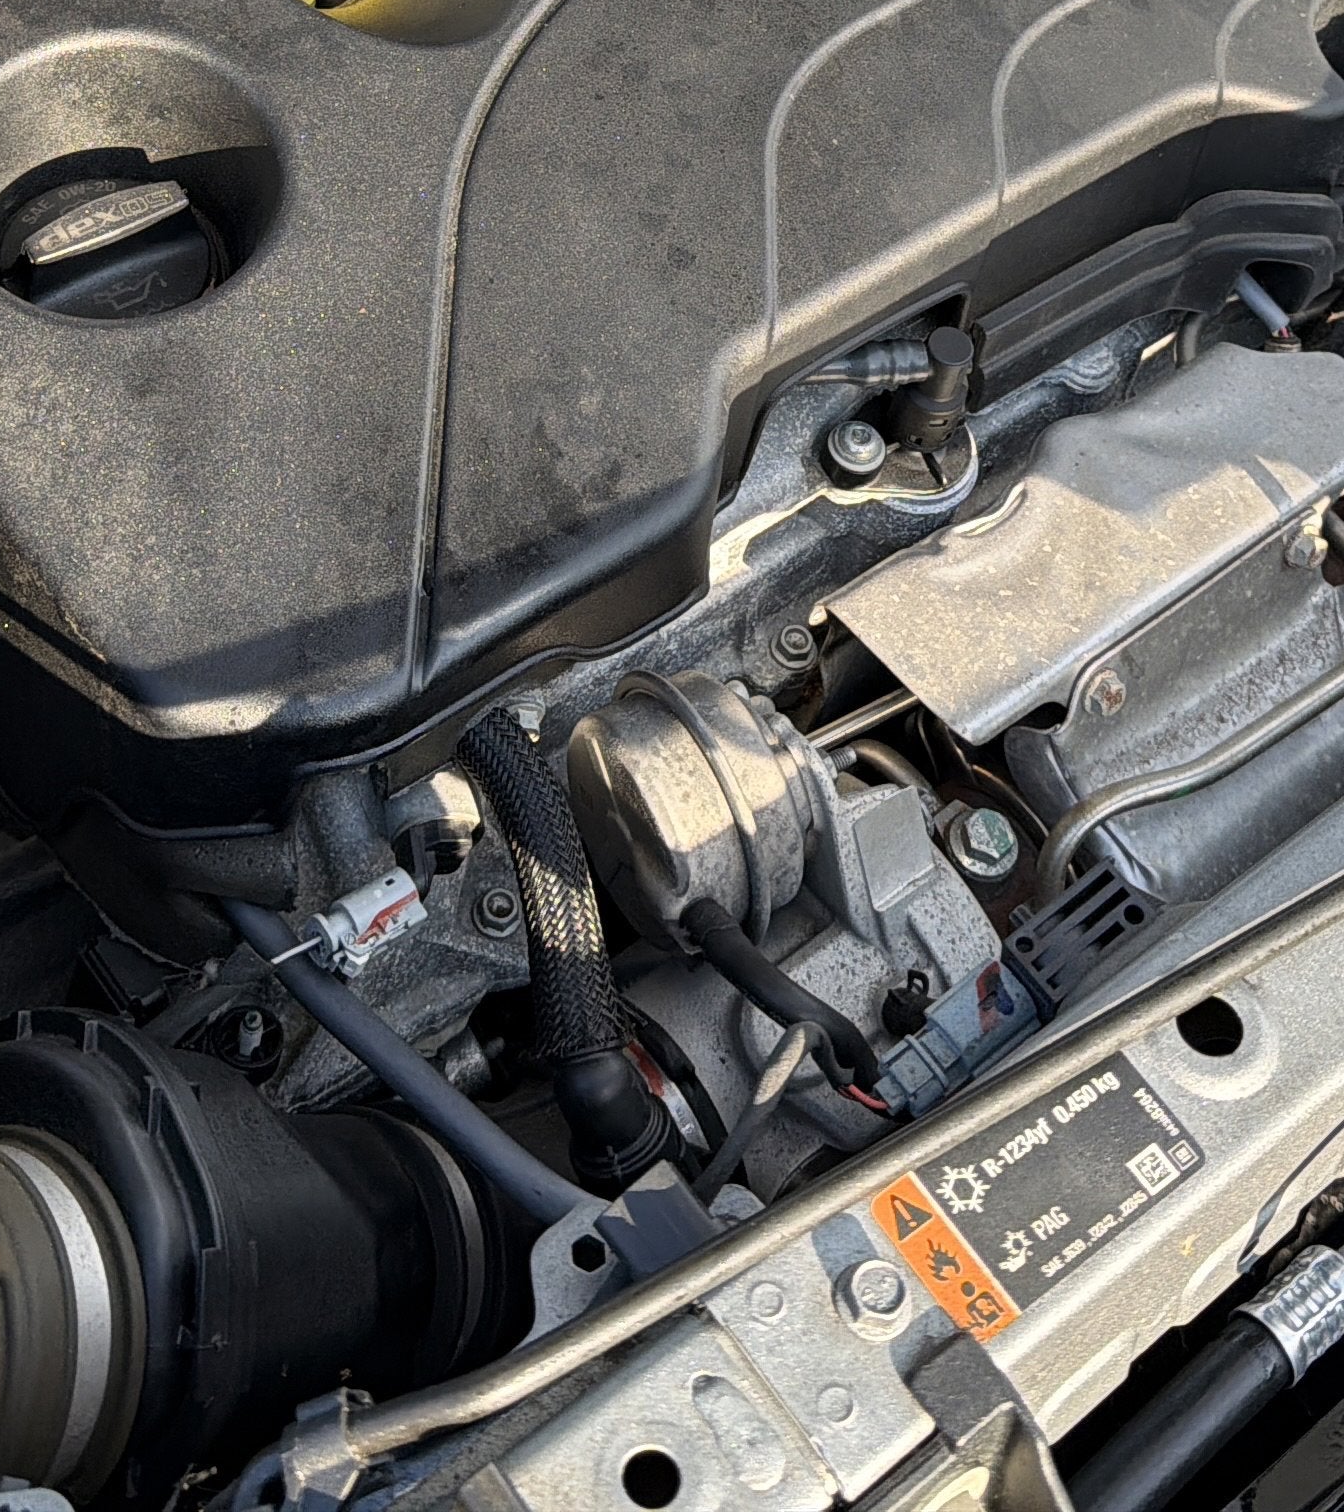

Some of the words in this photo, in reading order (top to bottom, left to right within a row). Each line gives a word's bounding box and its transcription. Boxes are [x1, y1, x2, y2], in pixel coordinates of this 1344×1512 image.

[22, 199, 53, 226] SAE
[38, 190, 174, 252] dexos
[980, 1117, 1053, 1178] R-1234yf
[1052, 1084, 1098, 1124] 0.450
[1090, 1071, 1121, 1094] kg
[1030, 1205, 1071, 1241] PAG
[1040, 1255, 1065, 1278] SAE
